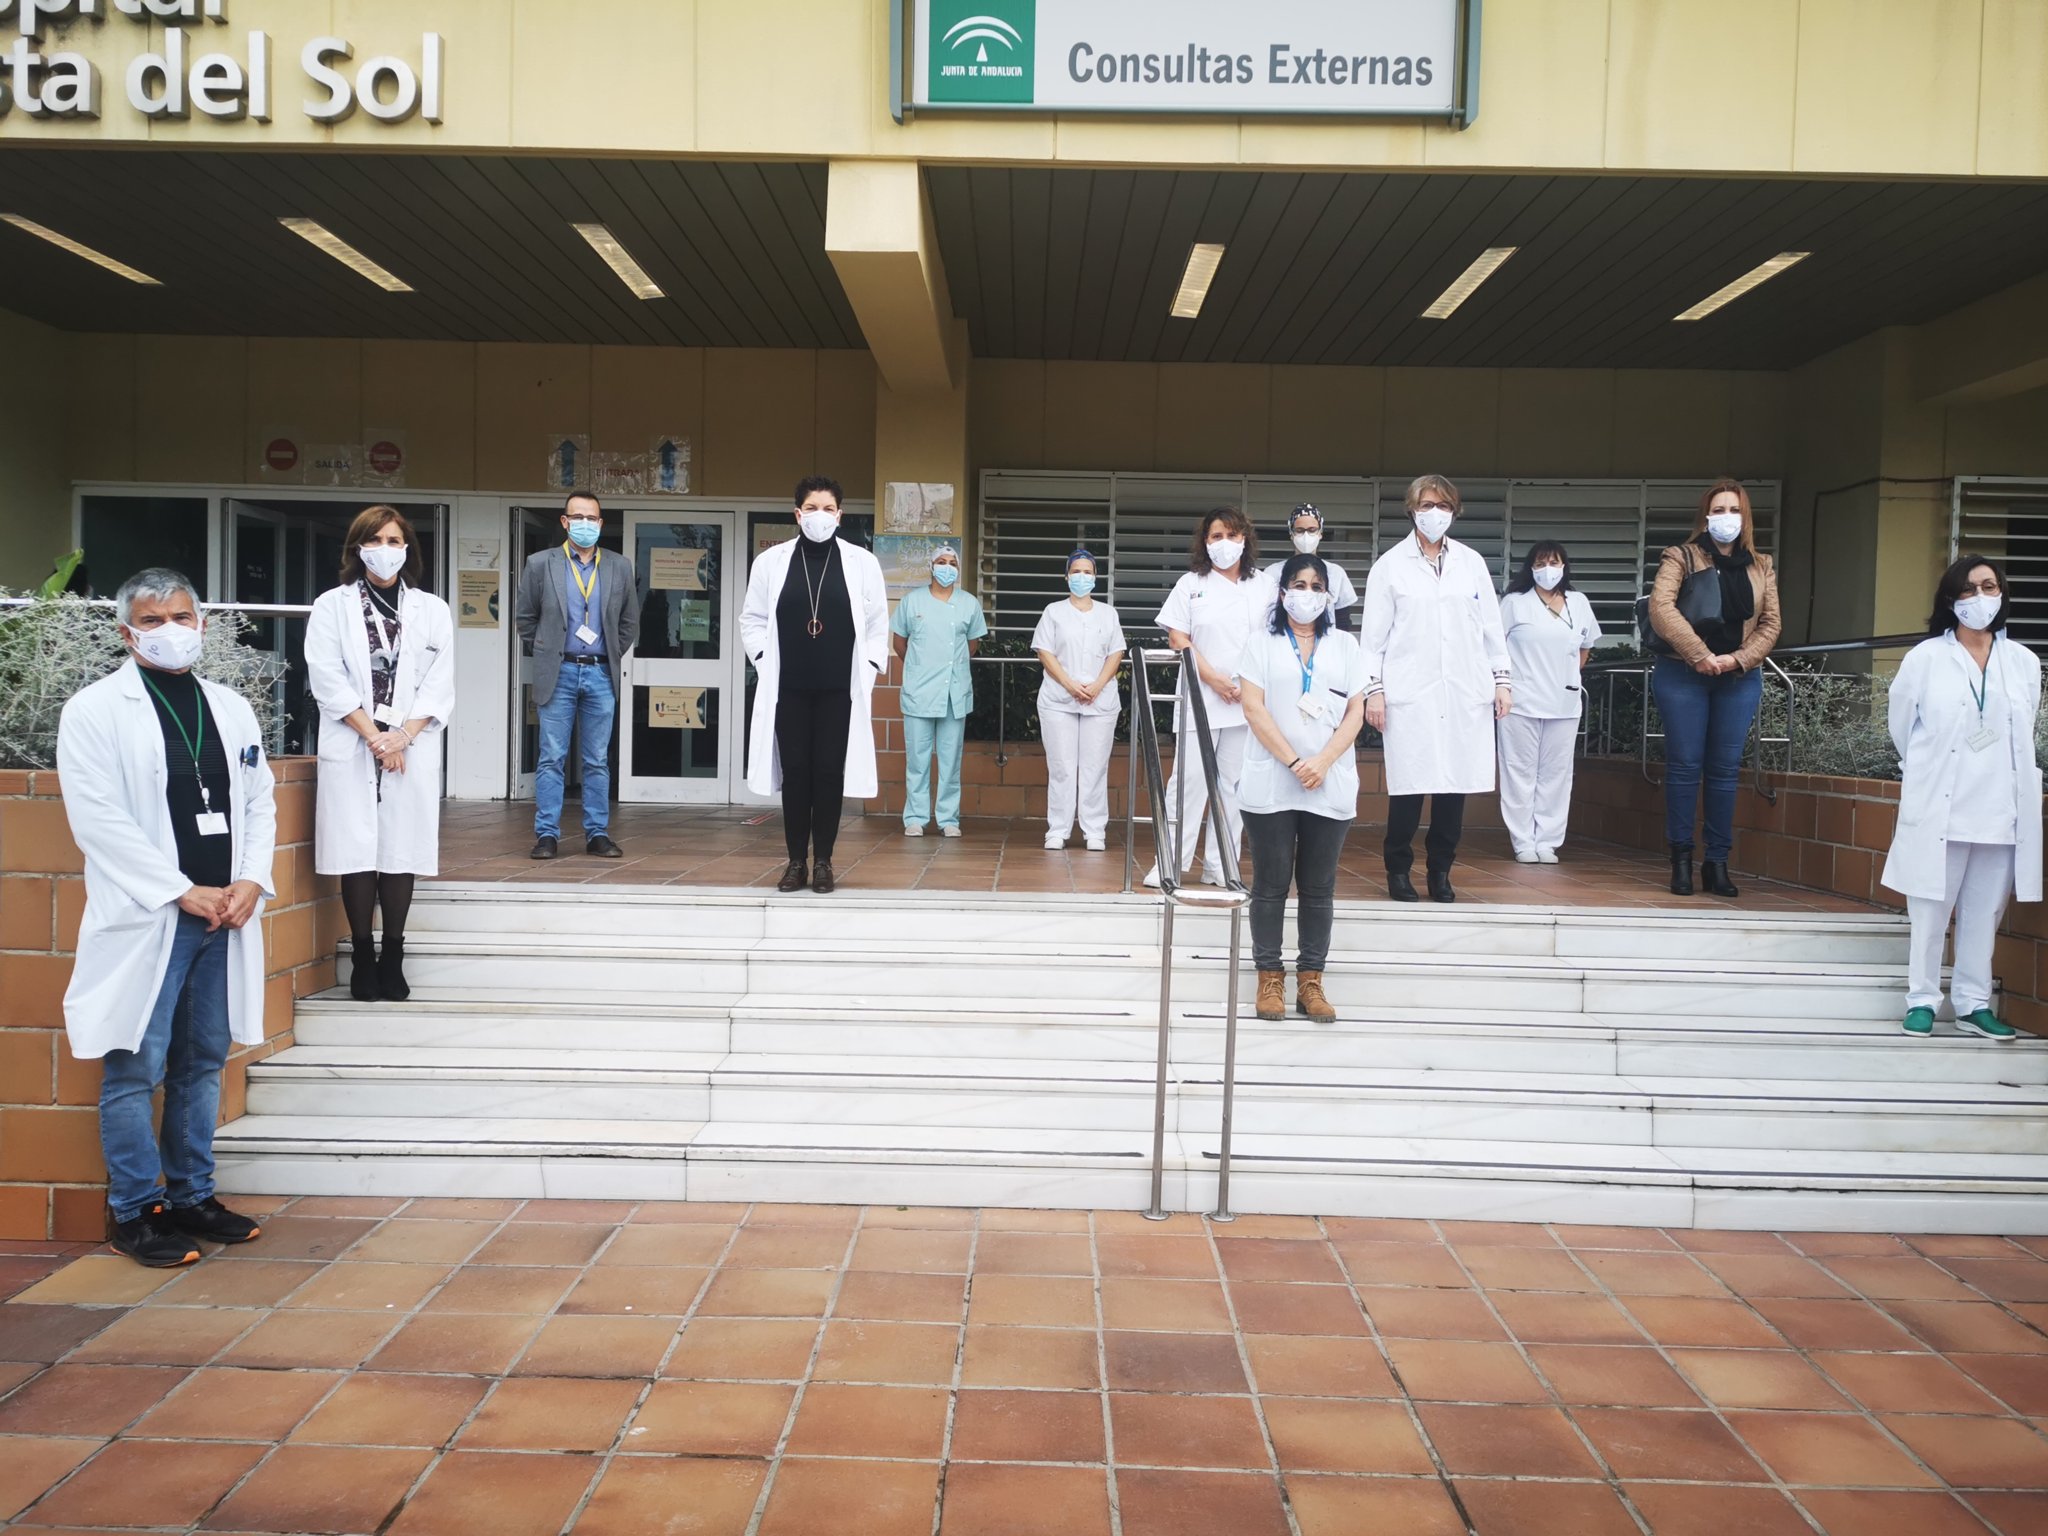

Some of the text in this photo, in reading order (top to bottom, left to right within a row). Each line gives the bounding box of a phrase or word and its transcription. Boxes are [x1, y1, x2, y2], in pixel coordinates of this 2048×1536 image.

[126, 27, 268, 120] del
[301, 31, 441, 121] Sol
[941, 65, 1023, 77] JUNTA DE ANDALUCIA
[1067, 41, 1434, 87] Consultas Externas
